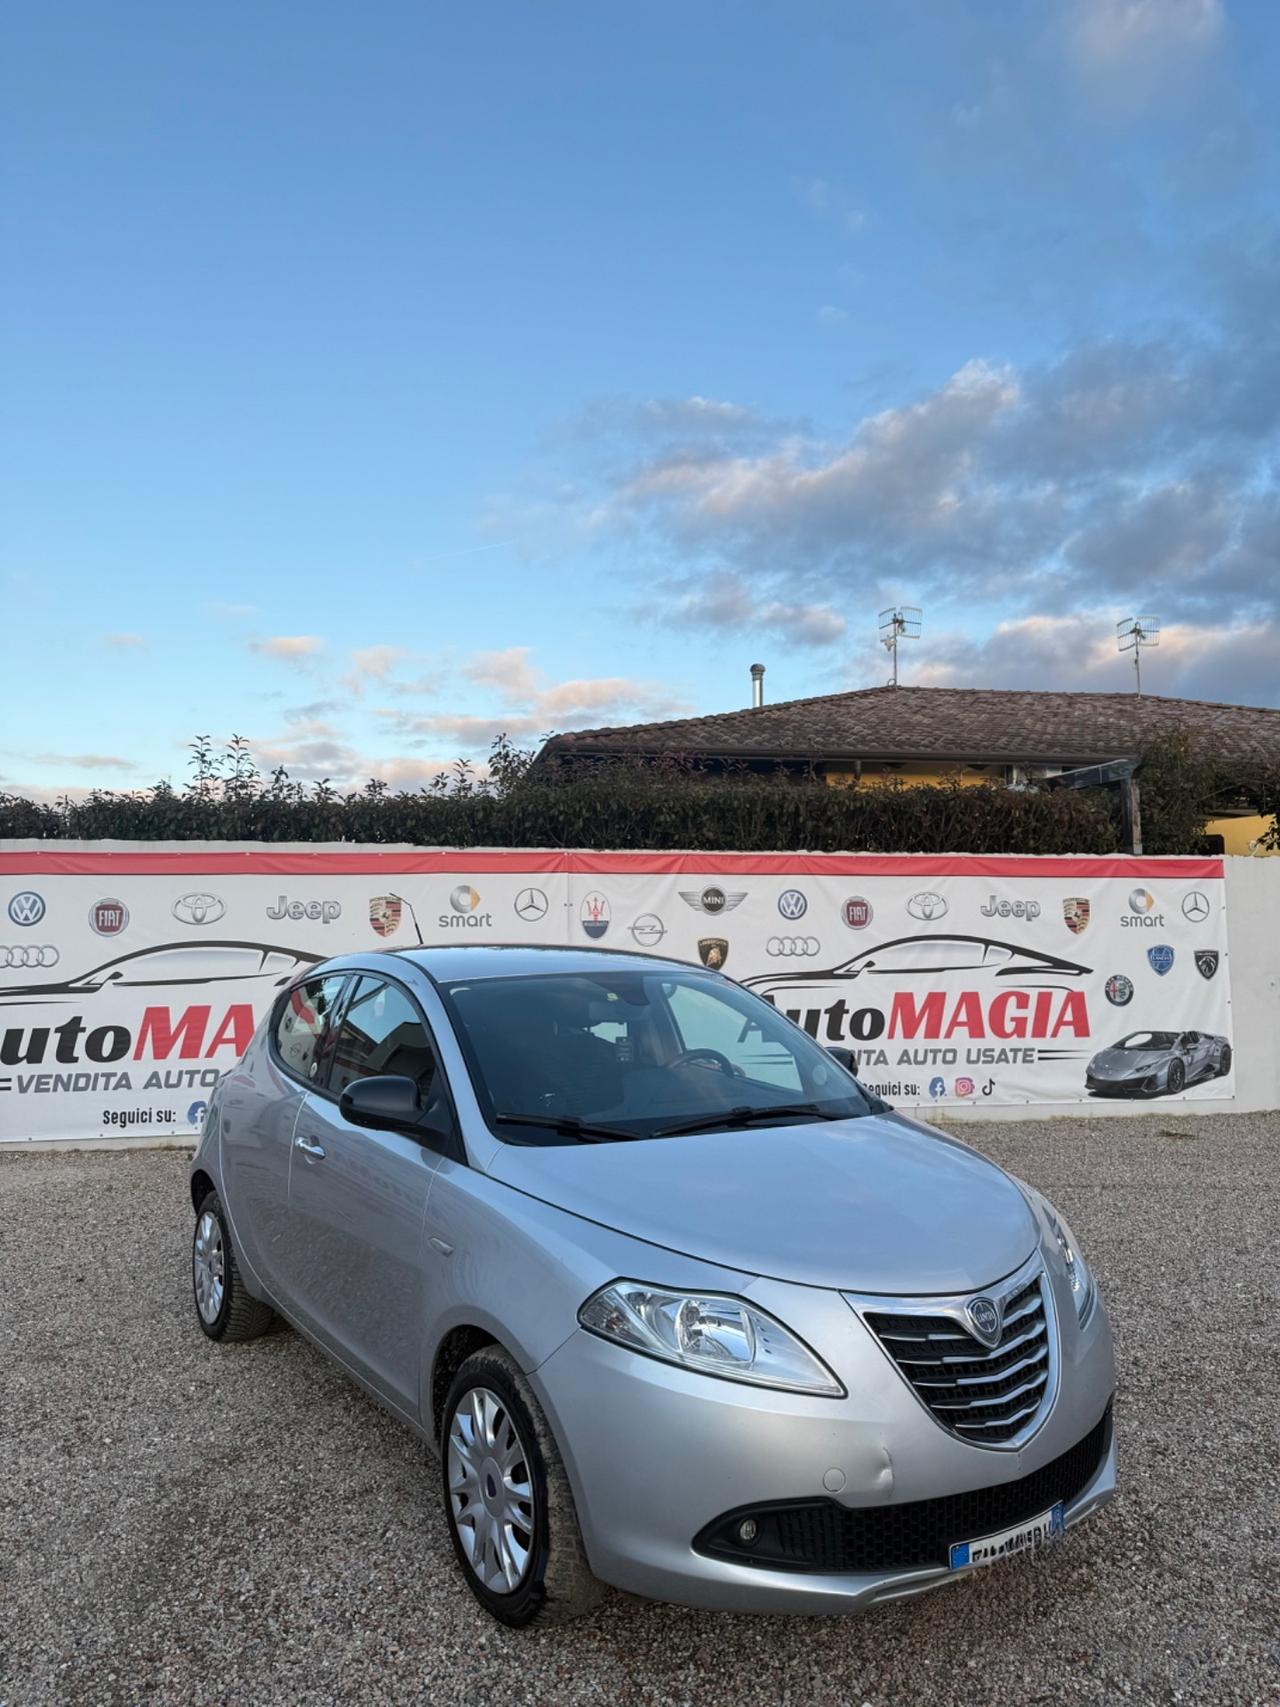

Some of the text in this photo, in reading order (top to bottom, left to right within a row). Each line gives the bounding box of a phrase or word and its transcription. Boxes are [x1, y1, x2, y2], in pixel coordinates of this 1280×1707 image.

[703, 896, 724, 904] MINI
[980, 895, 1041, 922] Jeep
[98, 910, 121, 927] FIAT
[266, 896, 342, 924] Jeep
[849, 907, 868, 921] FIAT
[438, 913, 492, 928] smart
[1120, 913, 1165, 928] smart
[897, 1048, 957, 1065] AUTO
[966, 1047, 1035, 1064] USATE
[17, 1069, 220, 1093] VENDITA AUTO
[863, 1081, 920, 1097] eguici su:
[103, 1107, 176, 1128] Seguici su:
